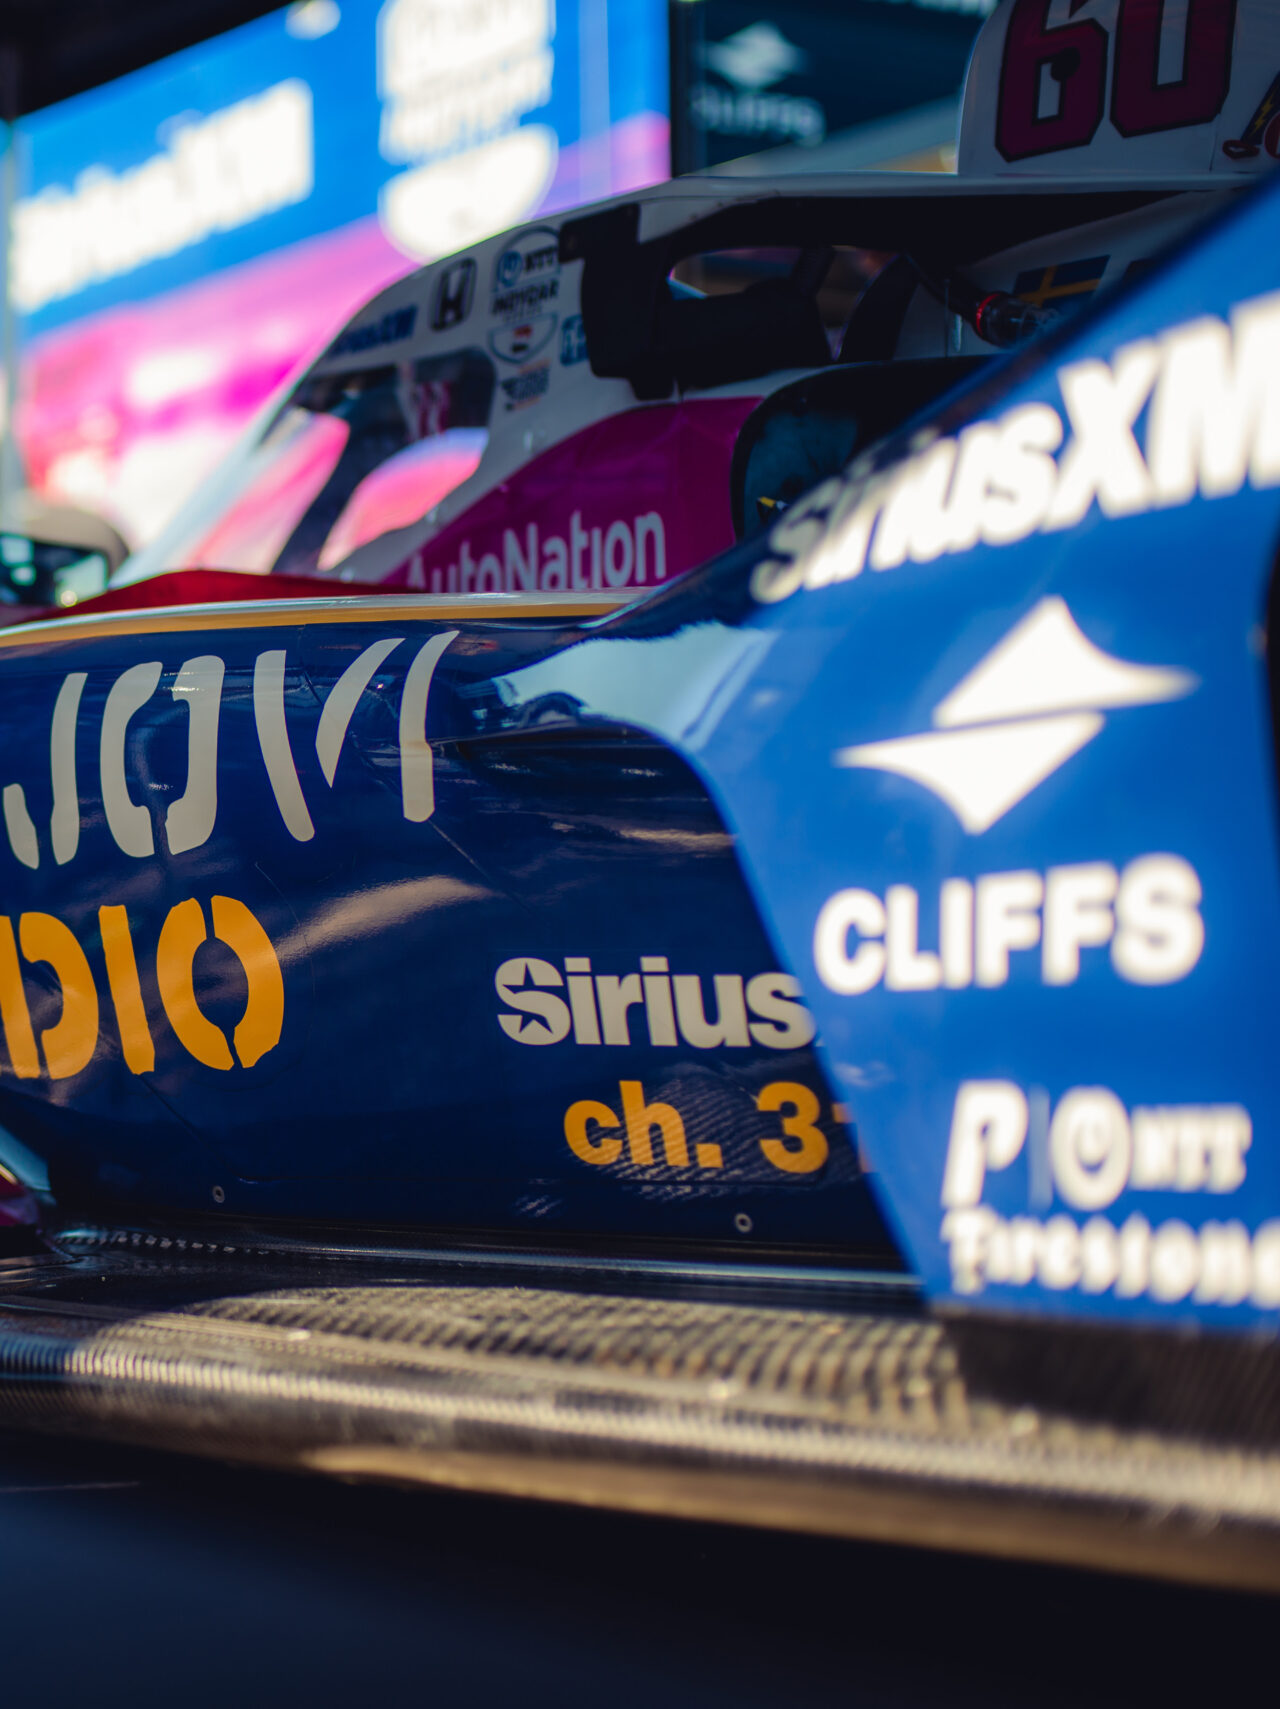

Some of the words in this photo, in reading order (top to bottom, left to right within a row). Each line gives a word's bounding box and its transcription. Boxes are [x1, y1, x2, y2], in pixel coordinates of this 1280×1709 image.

[994, 0, 1236, 163] 60
[3, 630, 460, 870] JOVI
[814, 853, 1204, 996] CLIFFS
[494, 956, 824, 1050] Sirius
[562, 1080, 724, 1169] ch.
[756, 1081, 874, 1175] 3
